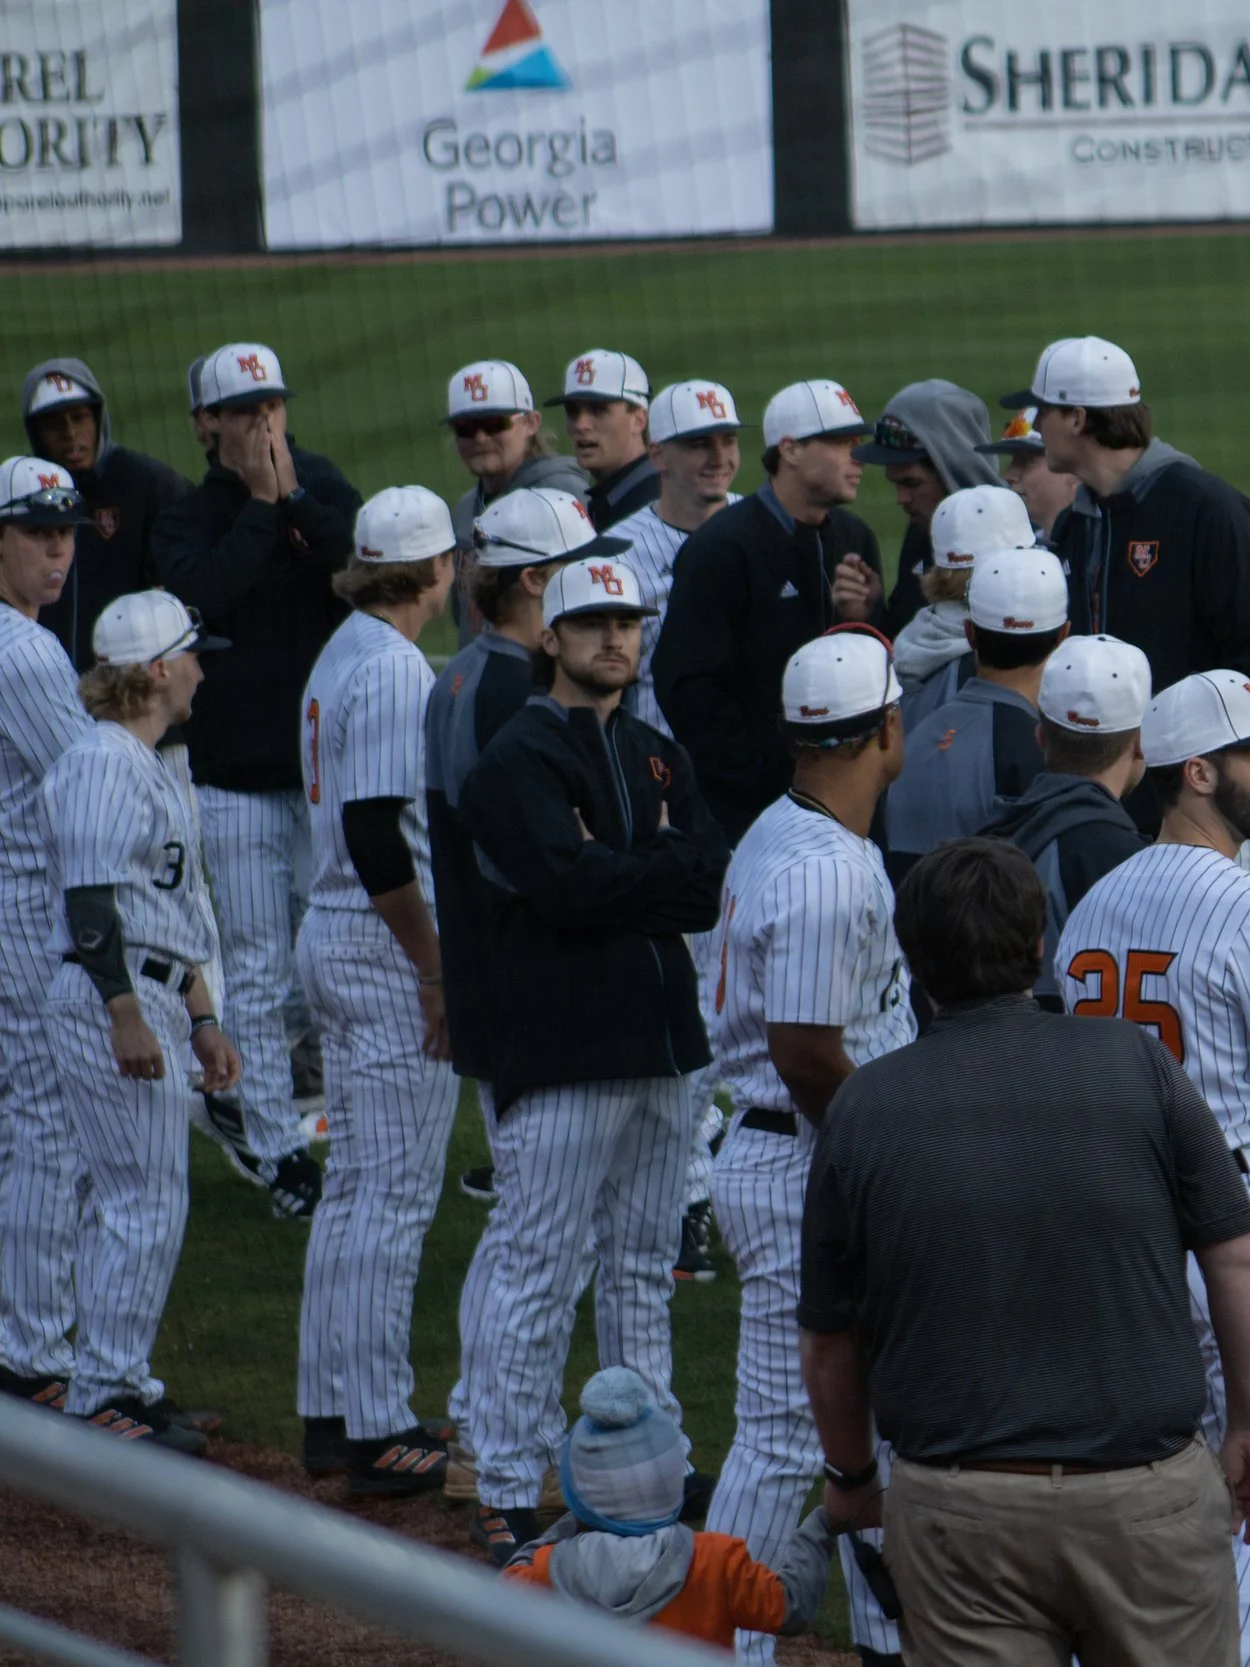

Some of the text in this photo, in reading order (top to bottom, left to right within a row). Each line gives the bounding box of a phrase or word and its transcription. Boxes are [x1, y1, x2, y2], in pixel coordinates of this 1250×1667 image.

[0, 50, 104, 102] REL
[0, 113, 166, 171] ORITY
[423, 115, 616, 177] Georgia
[446, 181, 597, 232] Power
[237, 353, 267, 382] MU
[464, 373, 488, 401] MU
[696, 390, 727, 418] MU
[588, 564, 623, 595] MU
[1067, 948, 1185, 1065] 25
